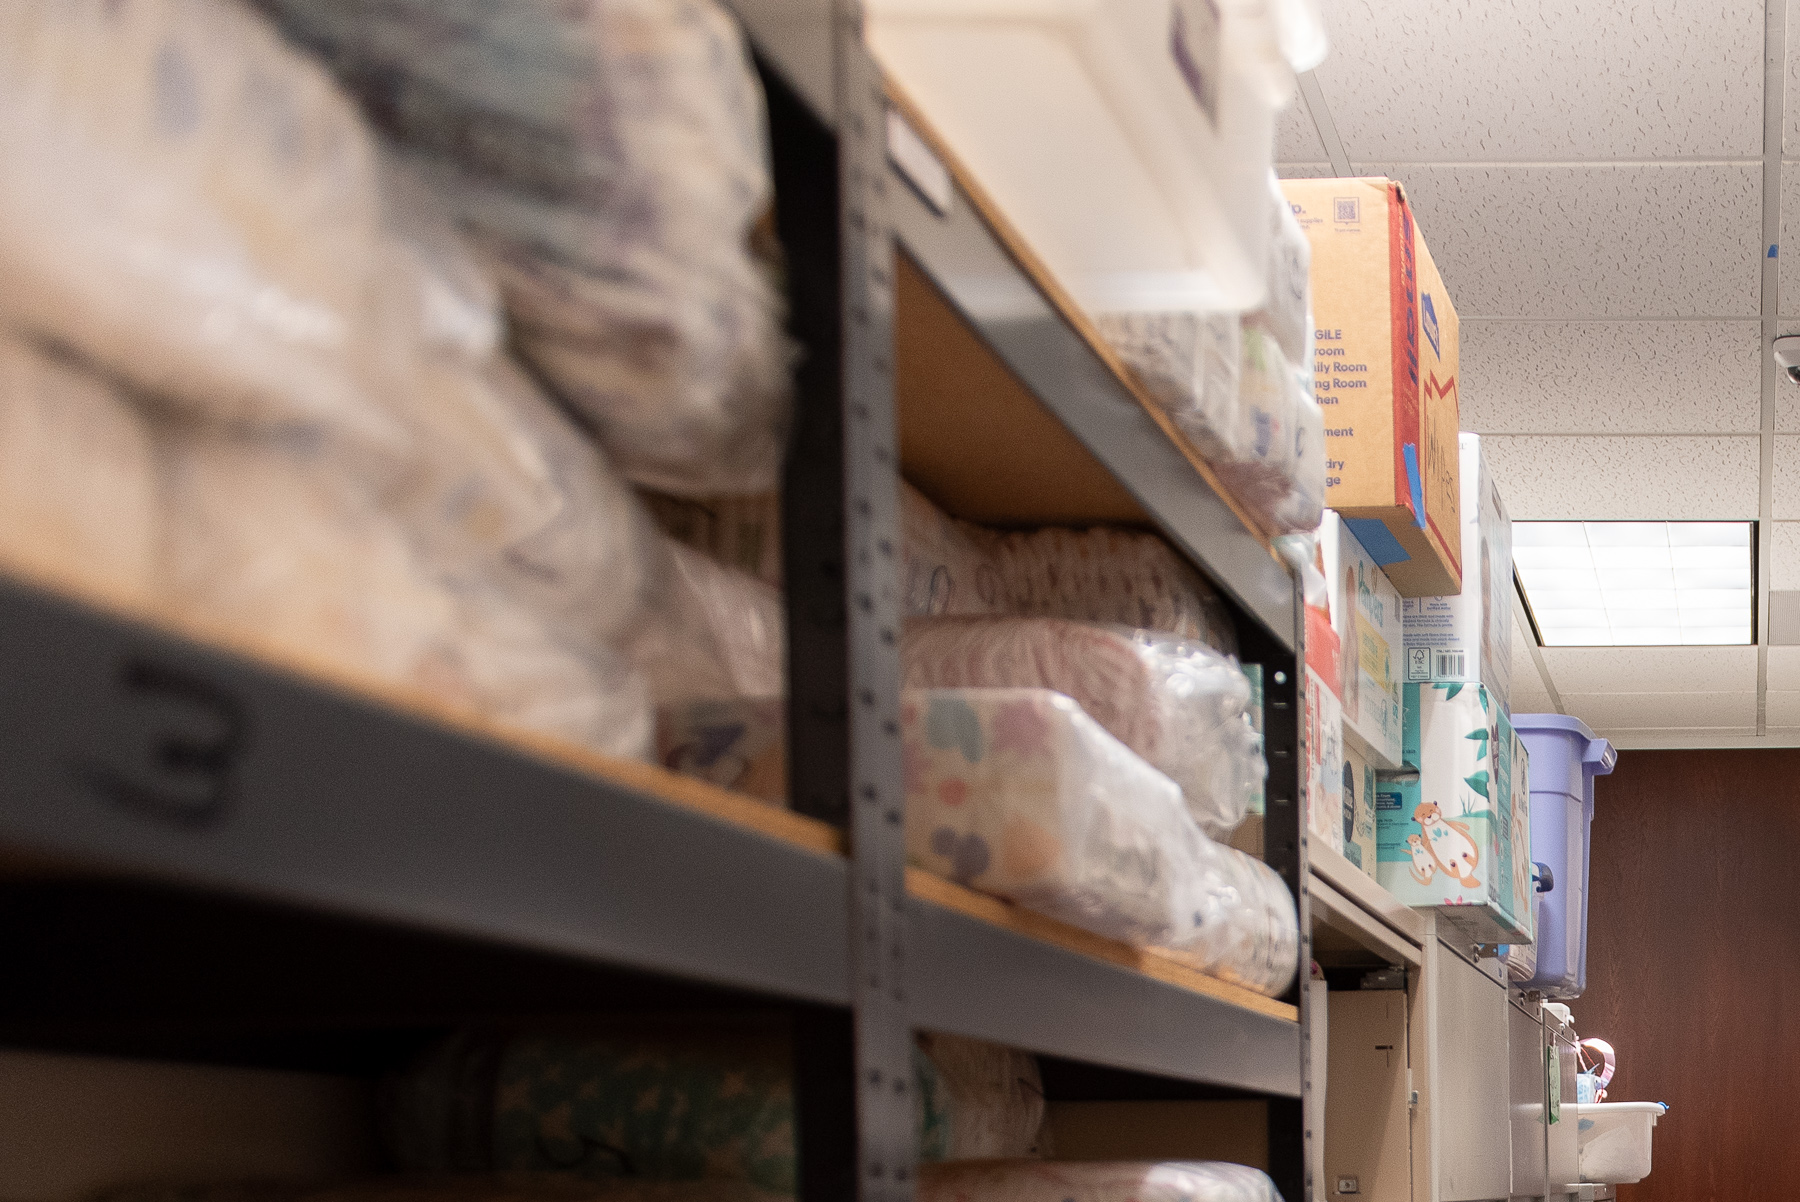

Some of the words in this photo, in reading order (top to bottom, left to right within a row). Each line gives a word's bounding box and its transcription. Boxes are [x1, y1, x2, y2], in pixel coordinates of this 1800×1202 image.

[1315, 329, 1342, 340] GILE
[1315, 347, 1345, 356] room
[1333, 361, 1367, 372] Room
[1333, 378, 1367, 388] Room
[1324, 427, 1354, 437] ment
[80, 655, 252, 832] 3
